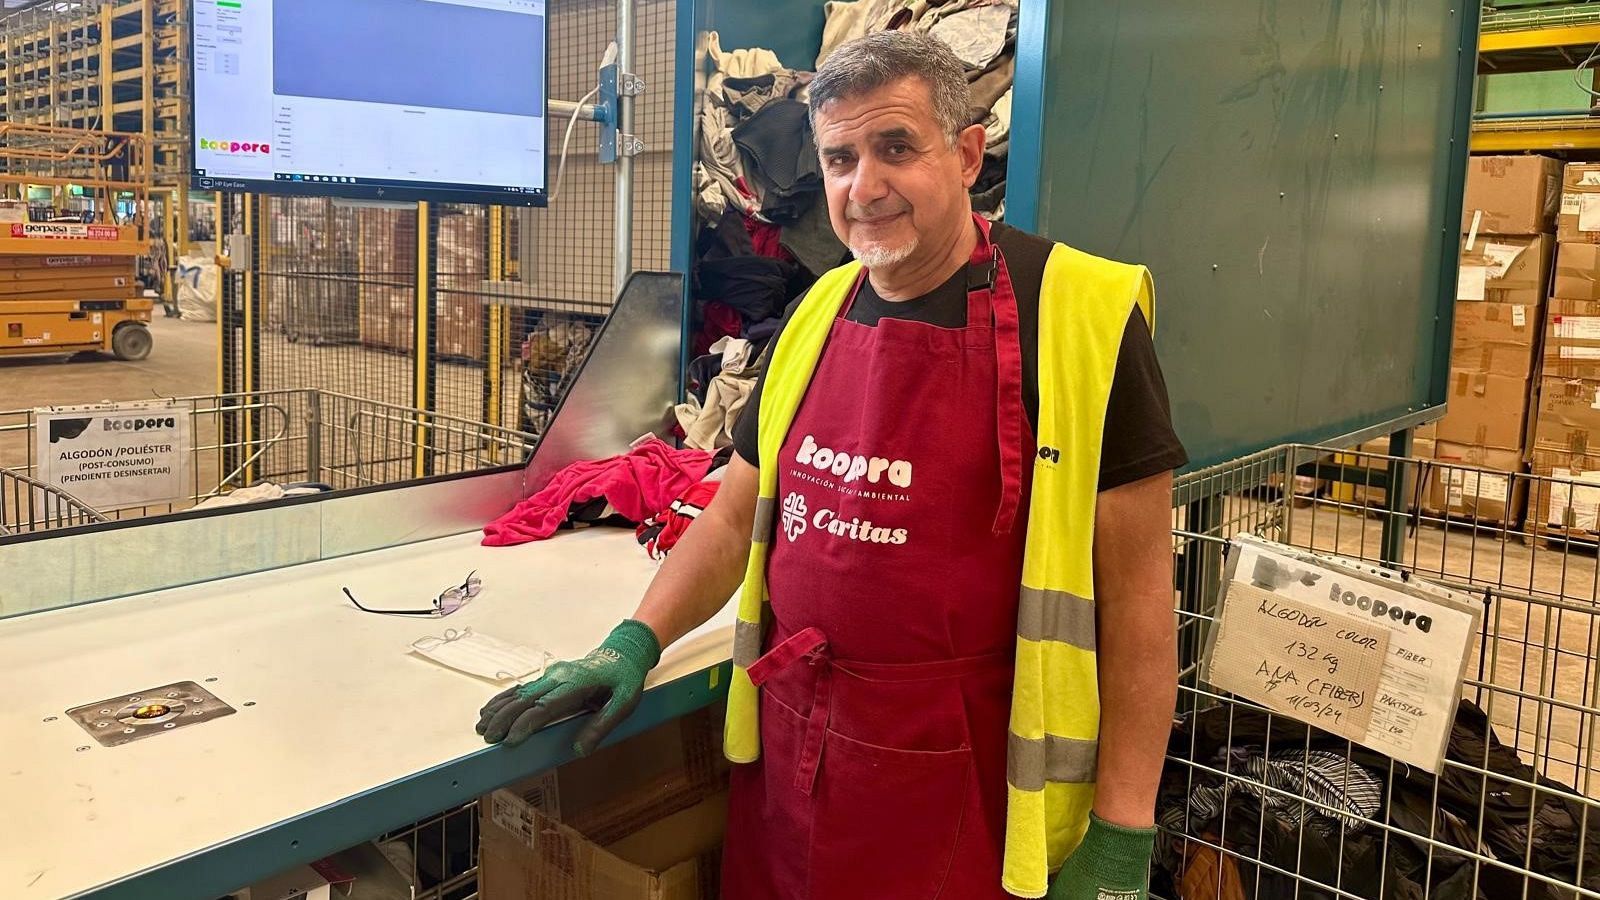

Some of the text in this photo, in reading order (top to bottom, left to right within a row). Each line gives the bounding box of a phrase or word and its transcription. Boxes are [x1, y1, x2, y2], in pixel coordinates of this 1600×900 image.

[200, 138, 270, 154] koopera
[25, 224, 67, 232] gerpasa
[103, 416, 175, 432] koopera
[59, 443, 172, 461] ALGODÓN /POLIÉSTER
[78, 457, 154, 472] (POST-CONSUMO)
[60, 465, 171, 484] (PENDIENTE DESINSERTAR)
[858, 490, 911, 502] AMBIENTAL
[1329, 582, 1433, 634] koopera
[1335, 629, 1378, 650] COLOR
[1284, 640, 1319, 661] 132
[1395, 647, 1427, 665] FIBER
[1306, 678, 1365, 709] (FIBER)
